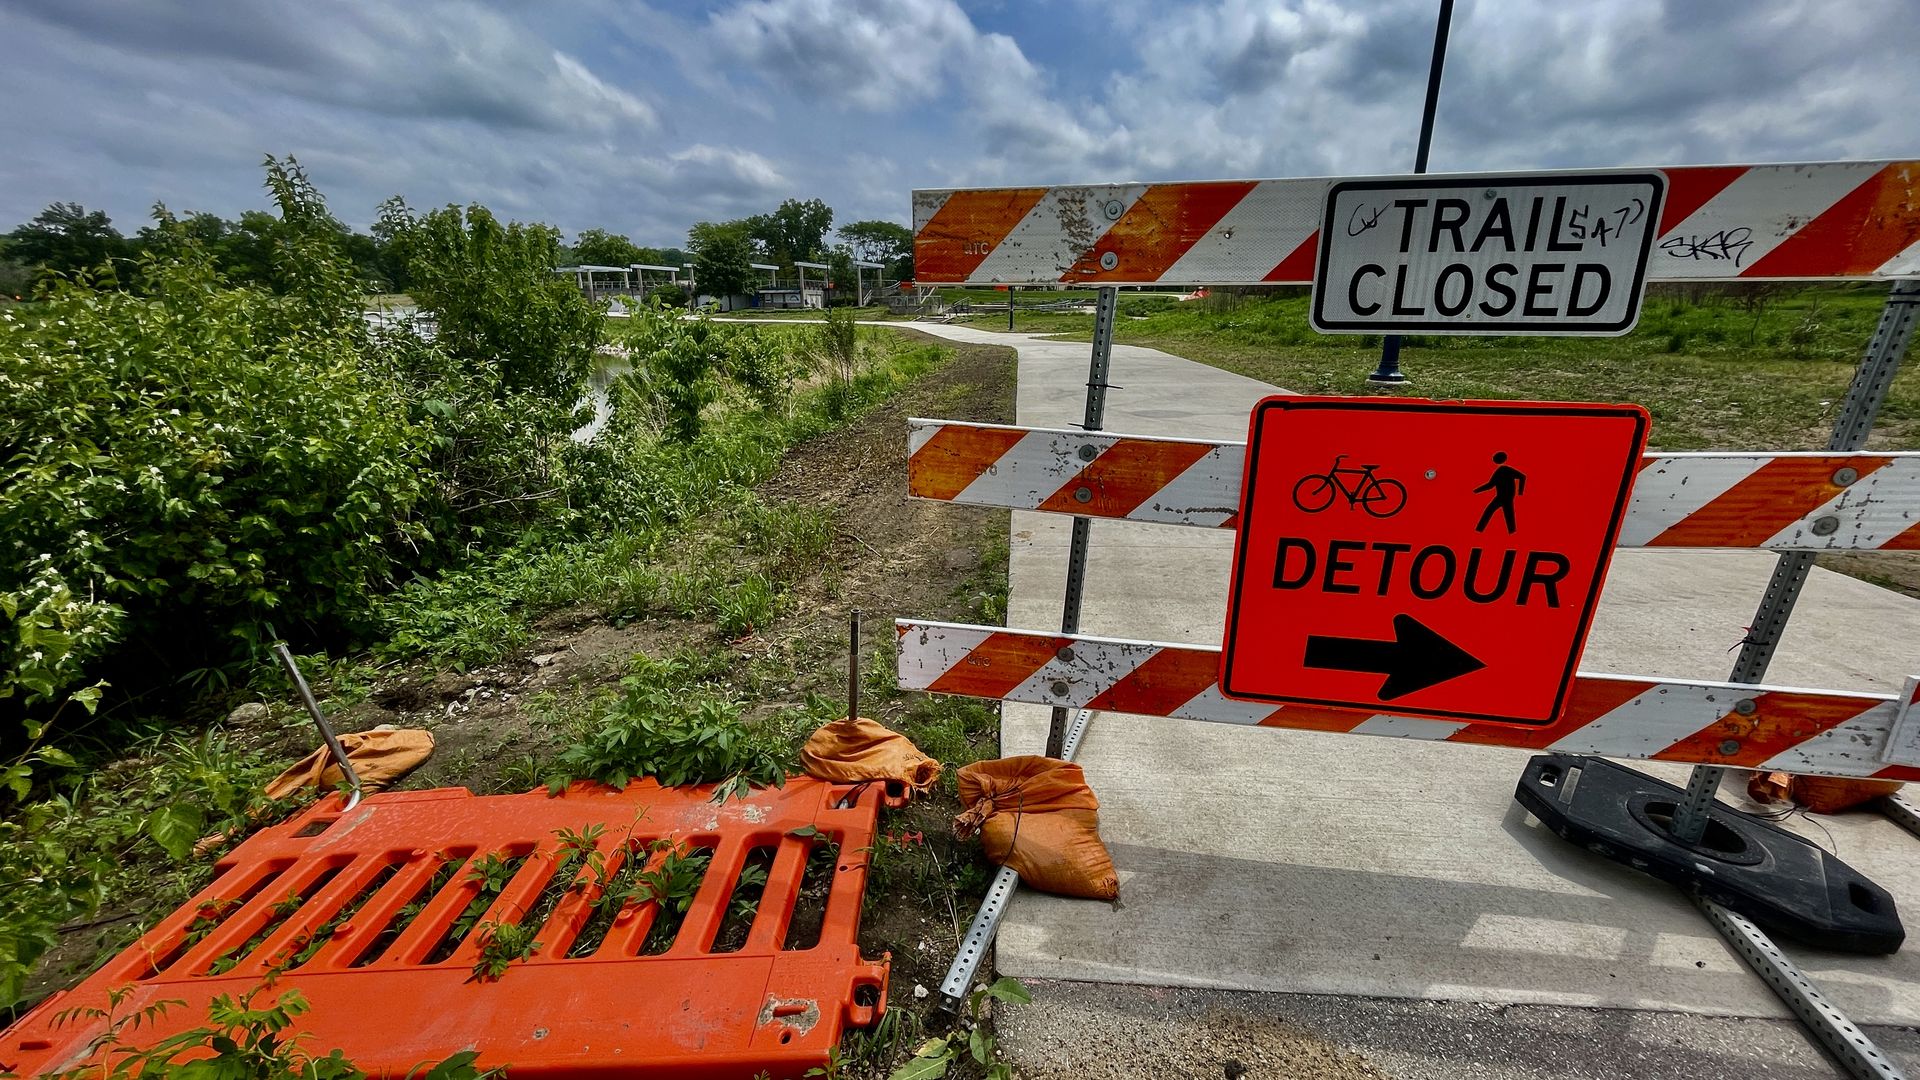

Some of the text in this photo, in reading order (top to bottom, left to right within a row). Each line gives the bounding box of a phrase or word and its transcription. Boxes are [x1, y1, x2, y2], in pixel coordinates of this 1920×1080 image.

[1393, 196, 1584, 254] TRAIL
[1348, 263, 1612, 318] CLOSED
[1271, 536, 1571, 609] DETOUR
